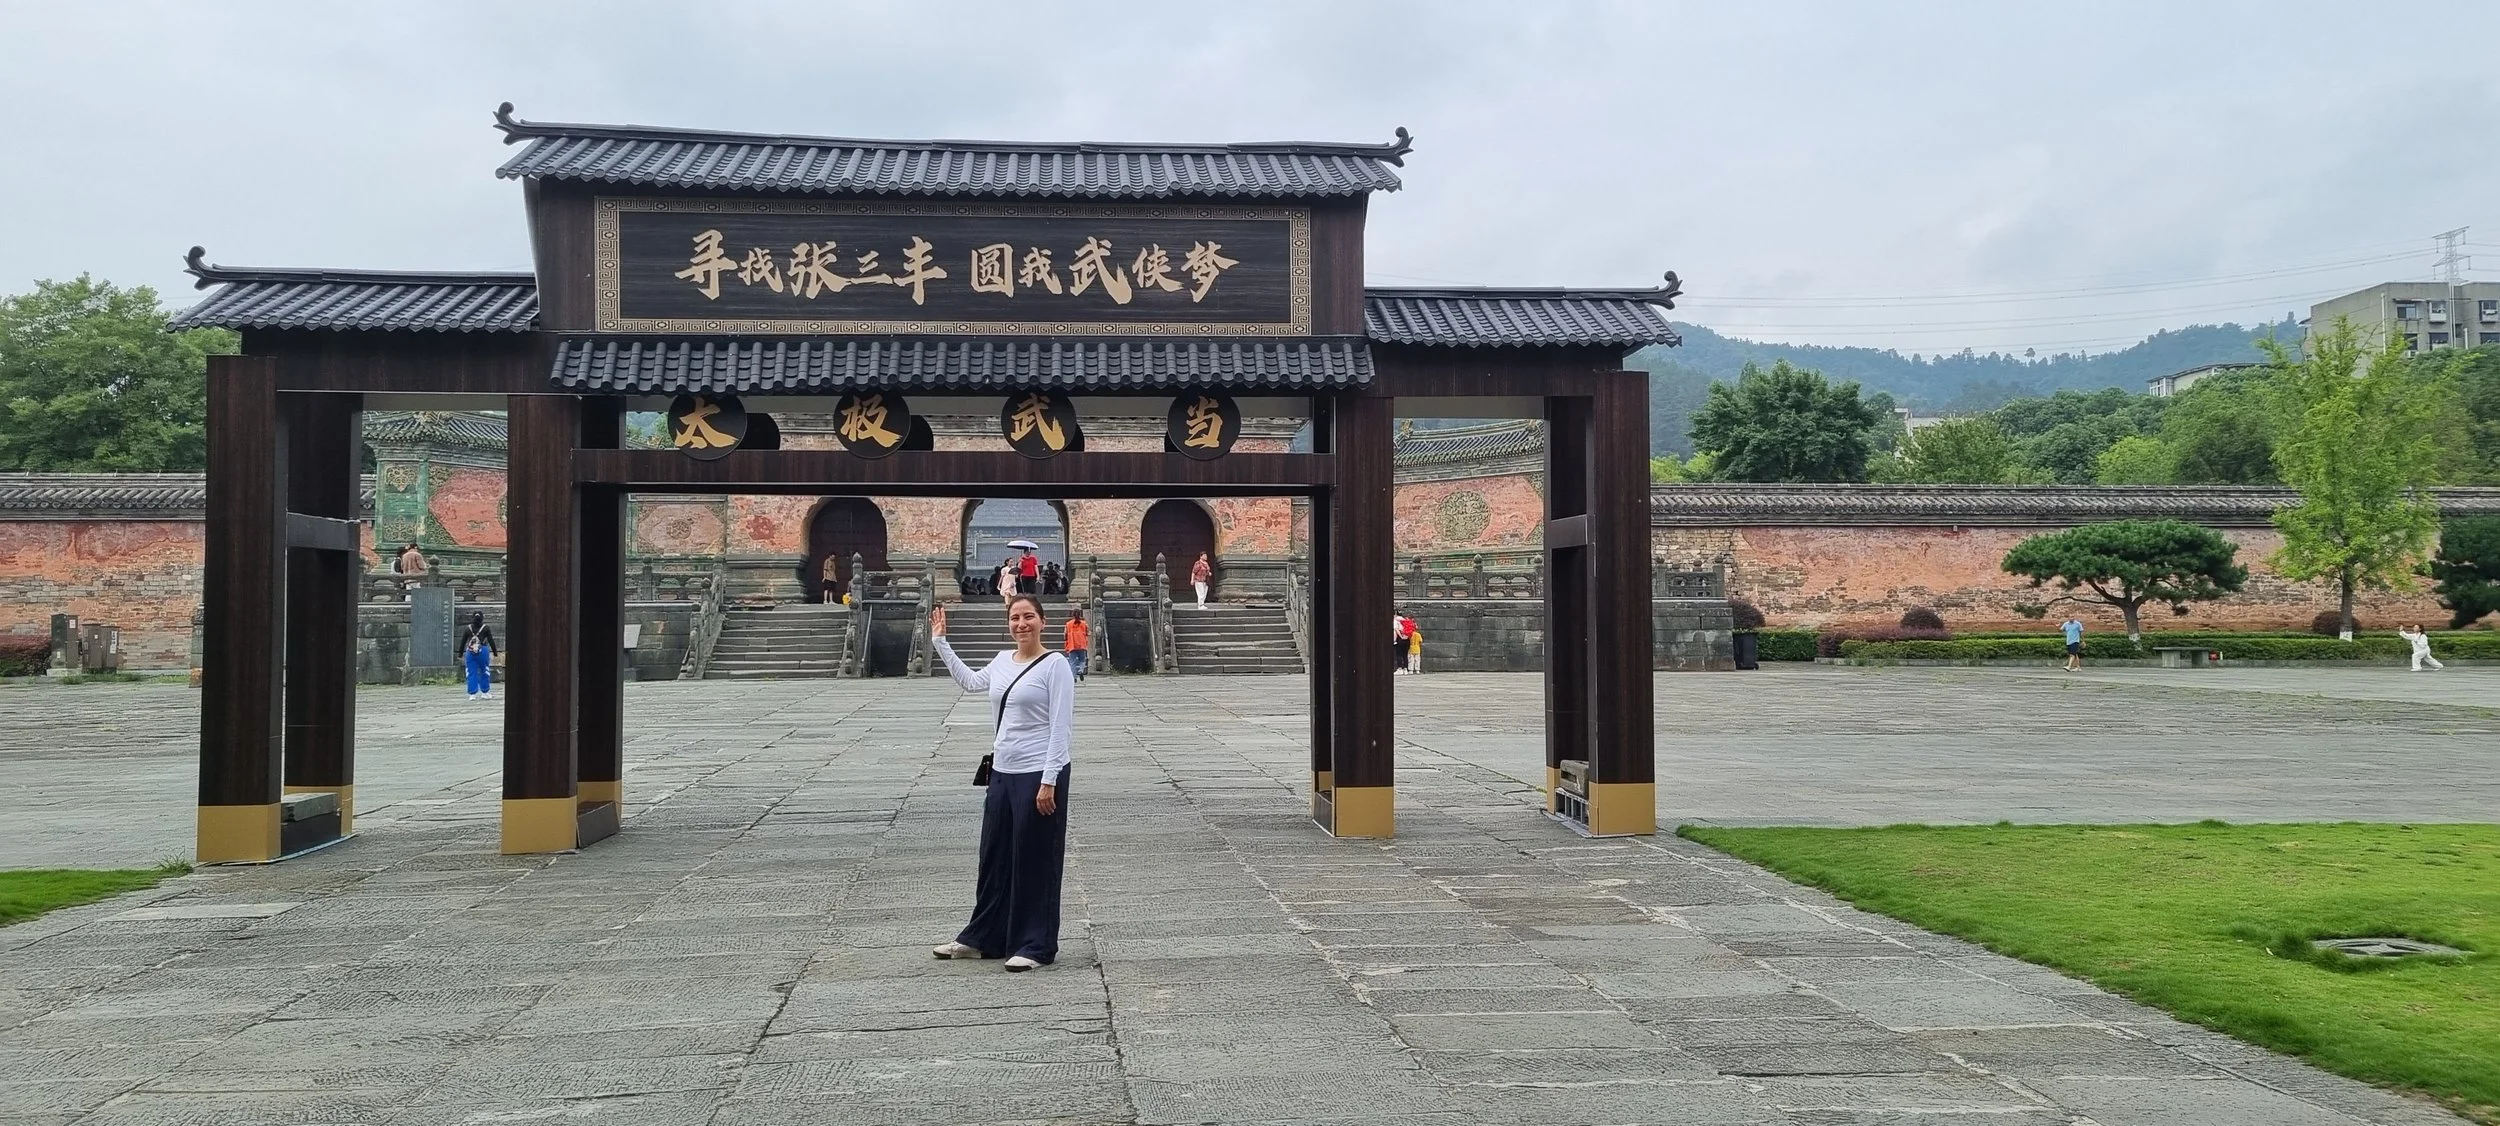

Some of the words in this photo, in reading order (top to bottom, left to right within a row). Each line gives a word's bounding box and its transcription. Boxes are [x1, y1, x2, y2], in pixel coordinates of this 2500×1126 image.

[674, 229, 947, 305] 寻找张三丰
[970, 236, 1240, 305] 圆我武侠梦
